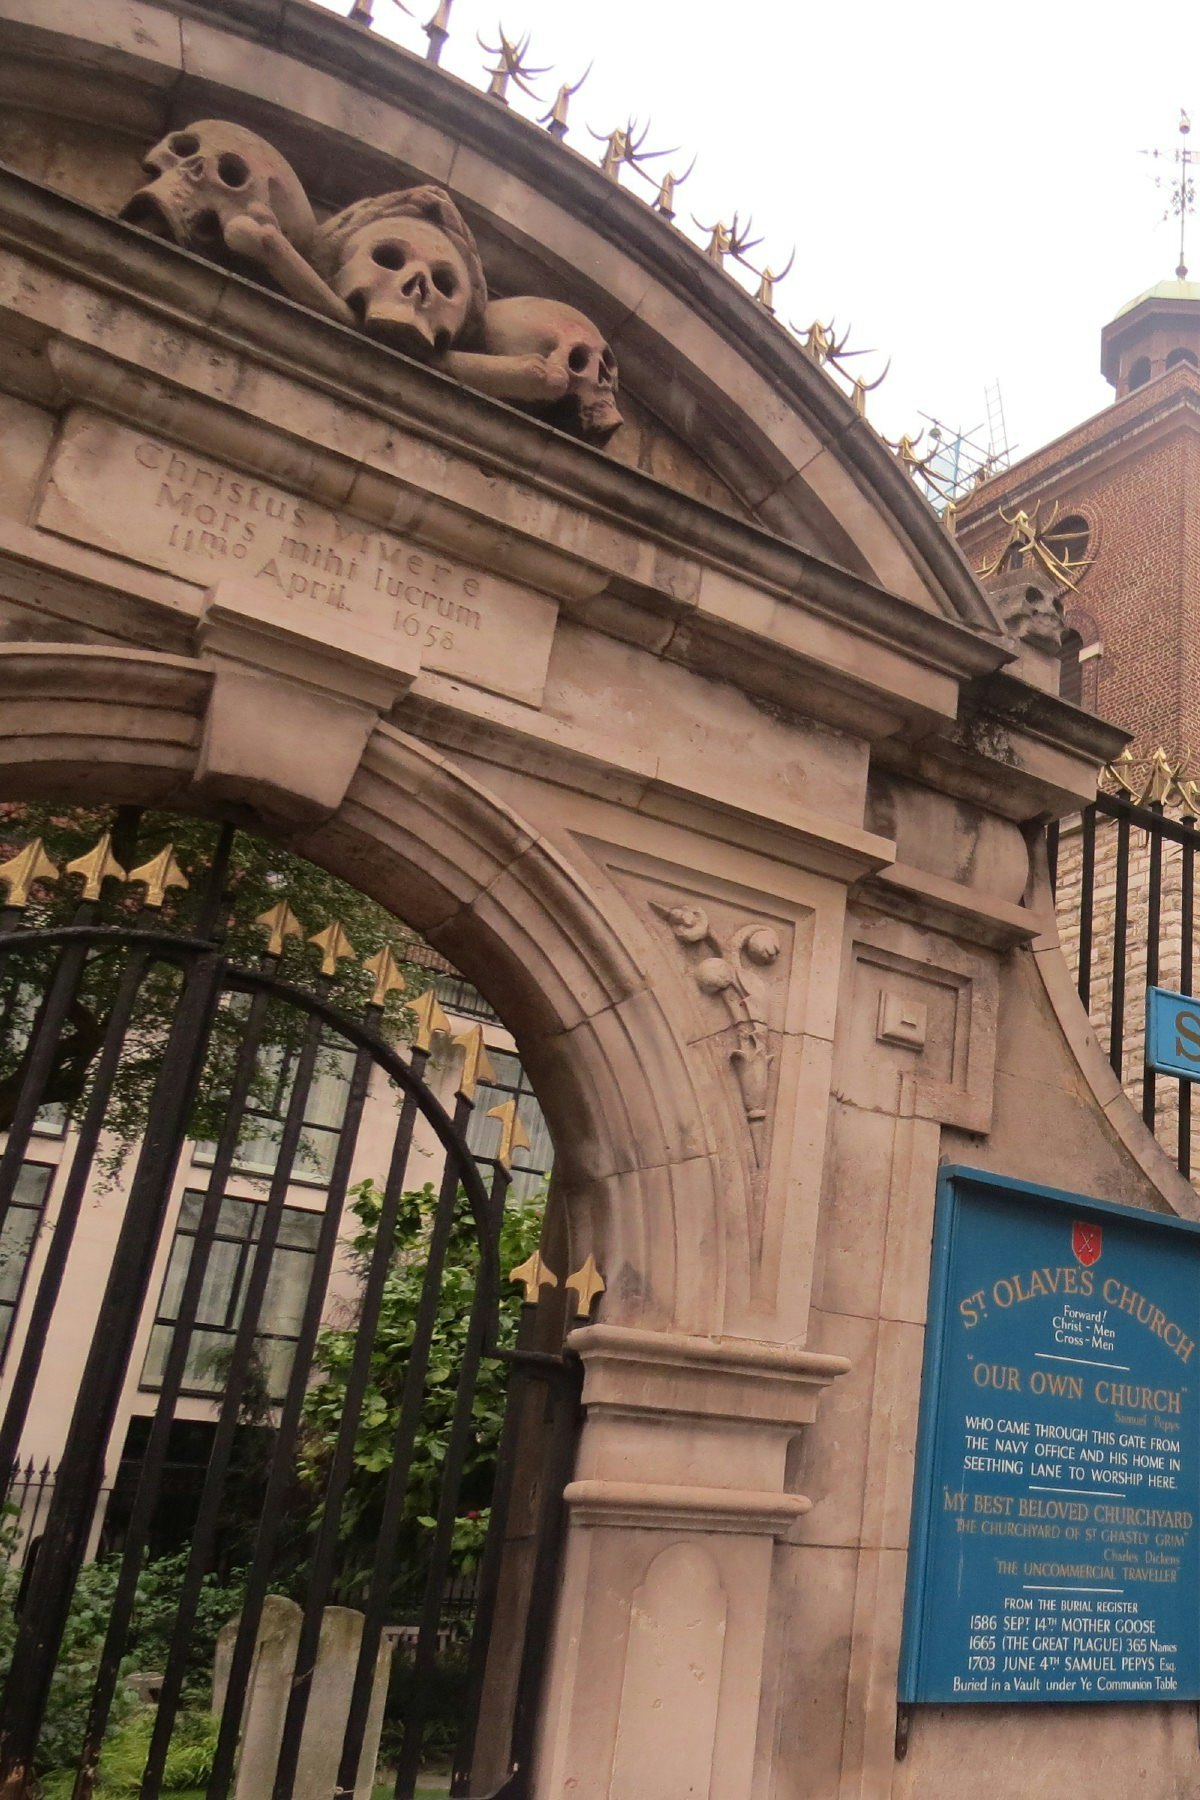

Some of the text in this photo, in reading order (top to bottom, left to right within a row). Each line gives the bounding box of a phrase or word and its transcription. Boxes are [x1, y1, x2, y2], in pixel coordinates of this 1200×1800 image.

[134, 441, 306, 529] Christus
[155, 481, 482, 631] Mors mihi lucrum
[392, 609, 456, 650] 1658
[993, 1266, 1094, 1309] OLAVE'S
[1102, 1279, 1196, 1364] CHURCH
[1064, 1304, 1107, 1323] Forward!
[1052, 1316, 1082, 1333] Christ
[1093, 1322, 1116, 1339] Men
[1029, 1371, 1084, 1400] OWN
[965, 1415, 1180, 1453] WHO CAME THROUGH THIS GATE FROM
[965, 1435, 1181, 1472] THE NAVY OFFICE AND HIS HOME IN
[963, 1455, 1023, 1475] SEETHING
[1030, 1462, 1062, 1478] LANE
[1068, 1466, 1085, 1481] TO
[1091, 1468, 1143, 1487] WORSHIP
[973, 1494, 1014, 1516] BEST
[1019, 1498, 1089, 1521] BELOVED
[1093, 1504, 1193, 1530] CHURCHYARD
[981, 1520, 1060, 1538] CHURCHYARD
[1065, 1527, 1080, 1541] OF
[1101, 1529, 1150, 1545] GHASTLY
[1103, 1548, 1180, 1566] Charles Dickens
[1024, 1561, 1116, 1580] UNCOMMERCIAL
[1004, 1598, 1138, 1613] FROM THE BURIAL REGISTER
[970, 1615, 997, 1630] 1586
[1061, 1618, 1110, 1633] MOTHER
[1115, 1619, 1156, 1634] GOOSE
[969, 1636, 1178, 1653] 1665 (THE GREAT PLAGUE) 365 Names
[968, 1656, 996, 1671] 1703
[1002, 1656, 1036, 1672] JUNE
[1064, 1657, 1116, 1672] SAMUEL
[1121, 1657, 1155, 1672] PEPYS
[953, 1675, 1178, 1692] Buried in a Vault under Ye Communion Table
